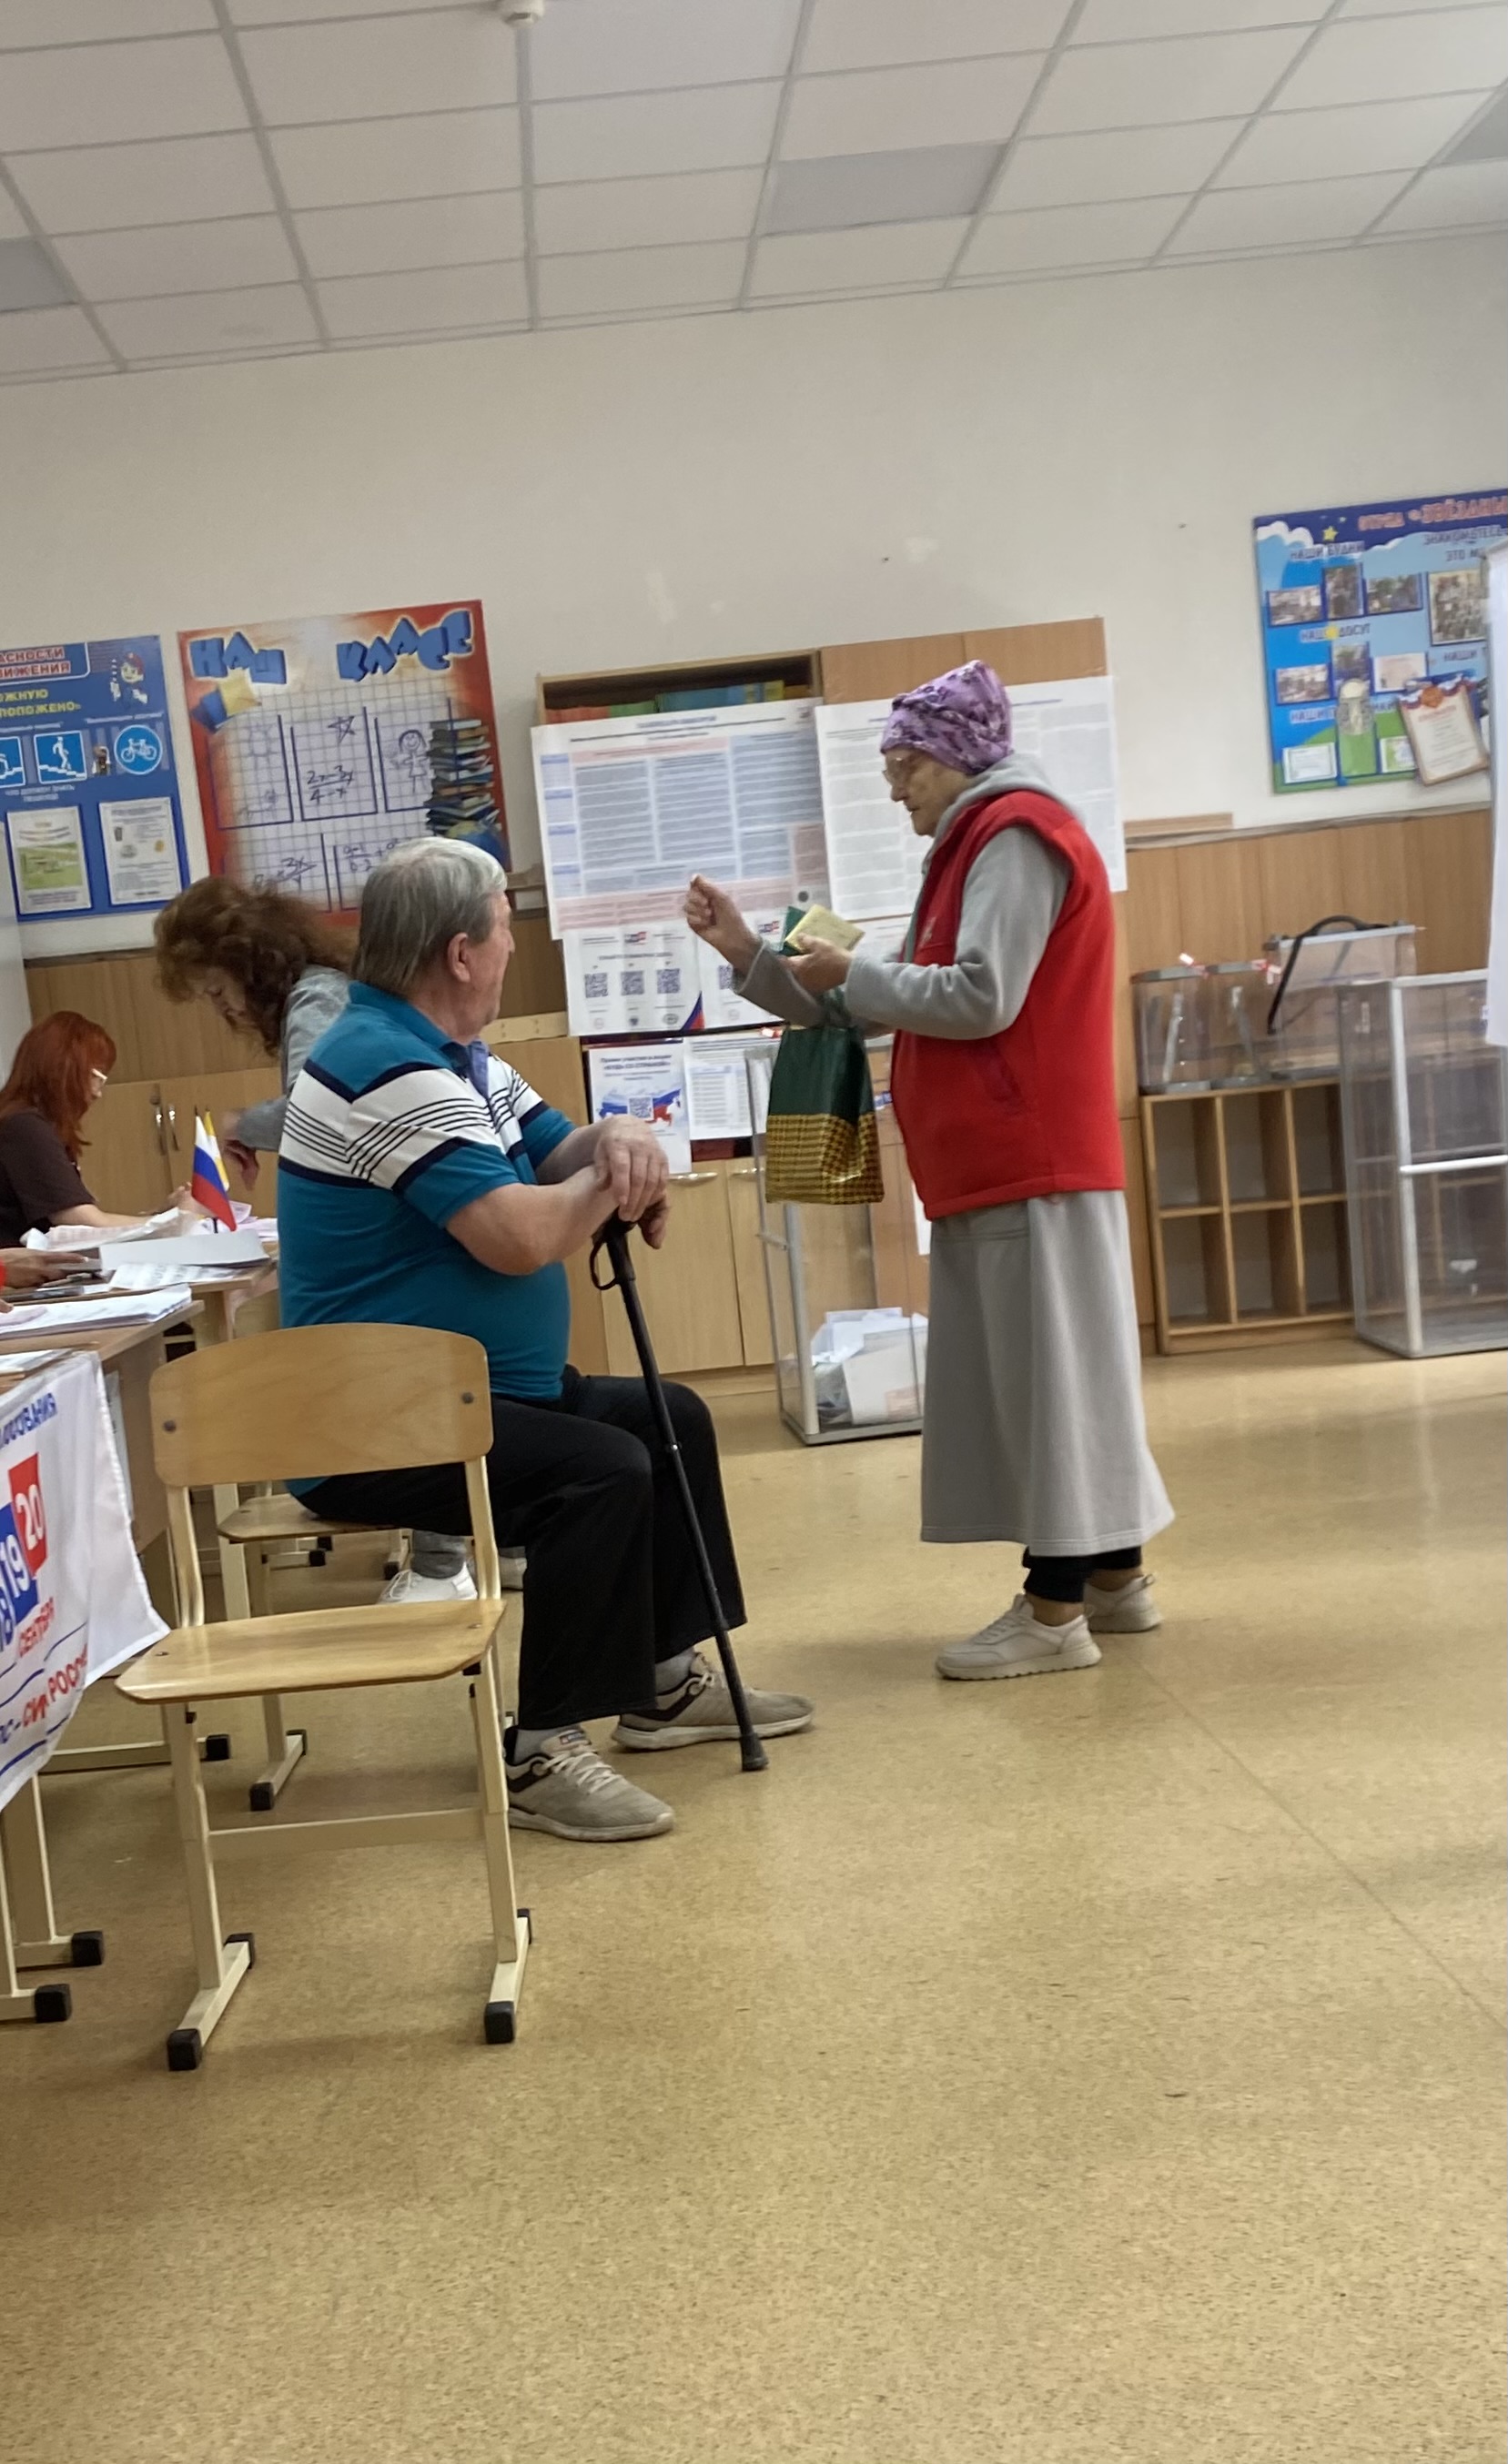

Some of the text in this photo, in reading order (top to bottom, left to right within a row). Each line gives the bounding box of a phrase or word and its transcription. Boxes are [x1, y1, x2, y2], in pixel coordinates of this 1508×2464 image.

[188, 611, 471, 685] НАШ КЛАСС
[15, 1484, 44, 1550] 20
[0, 1534, 30, 1598] 19
